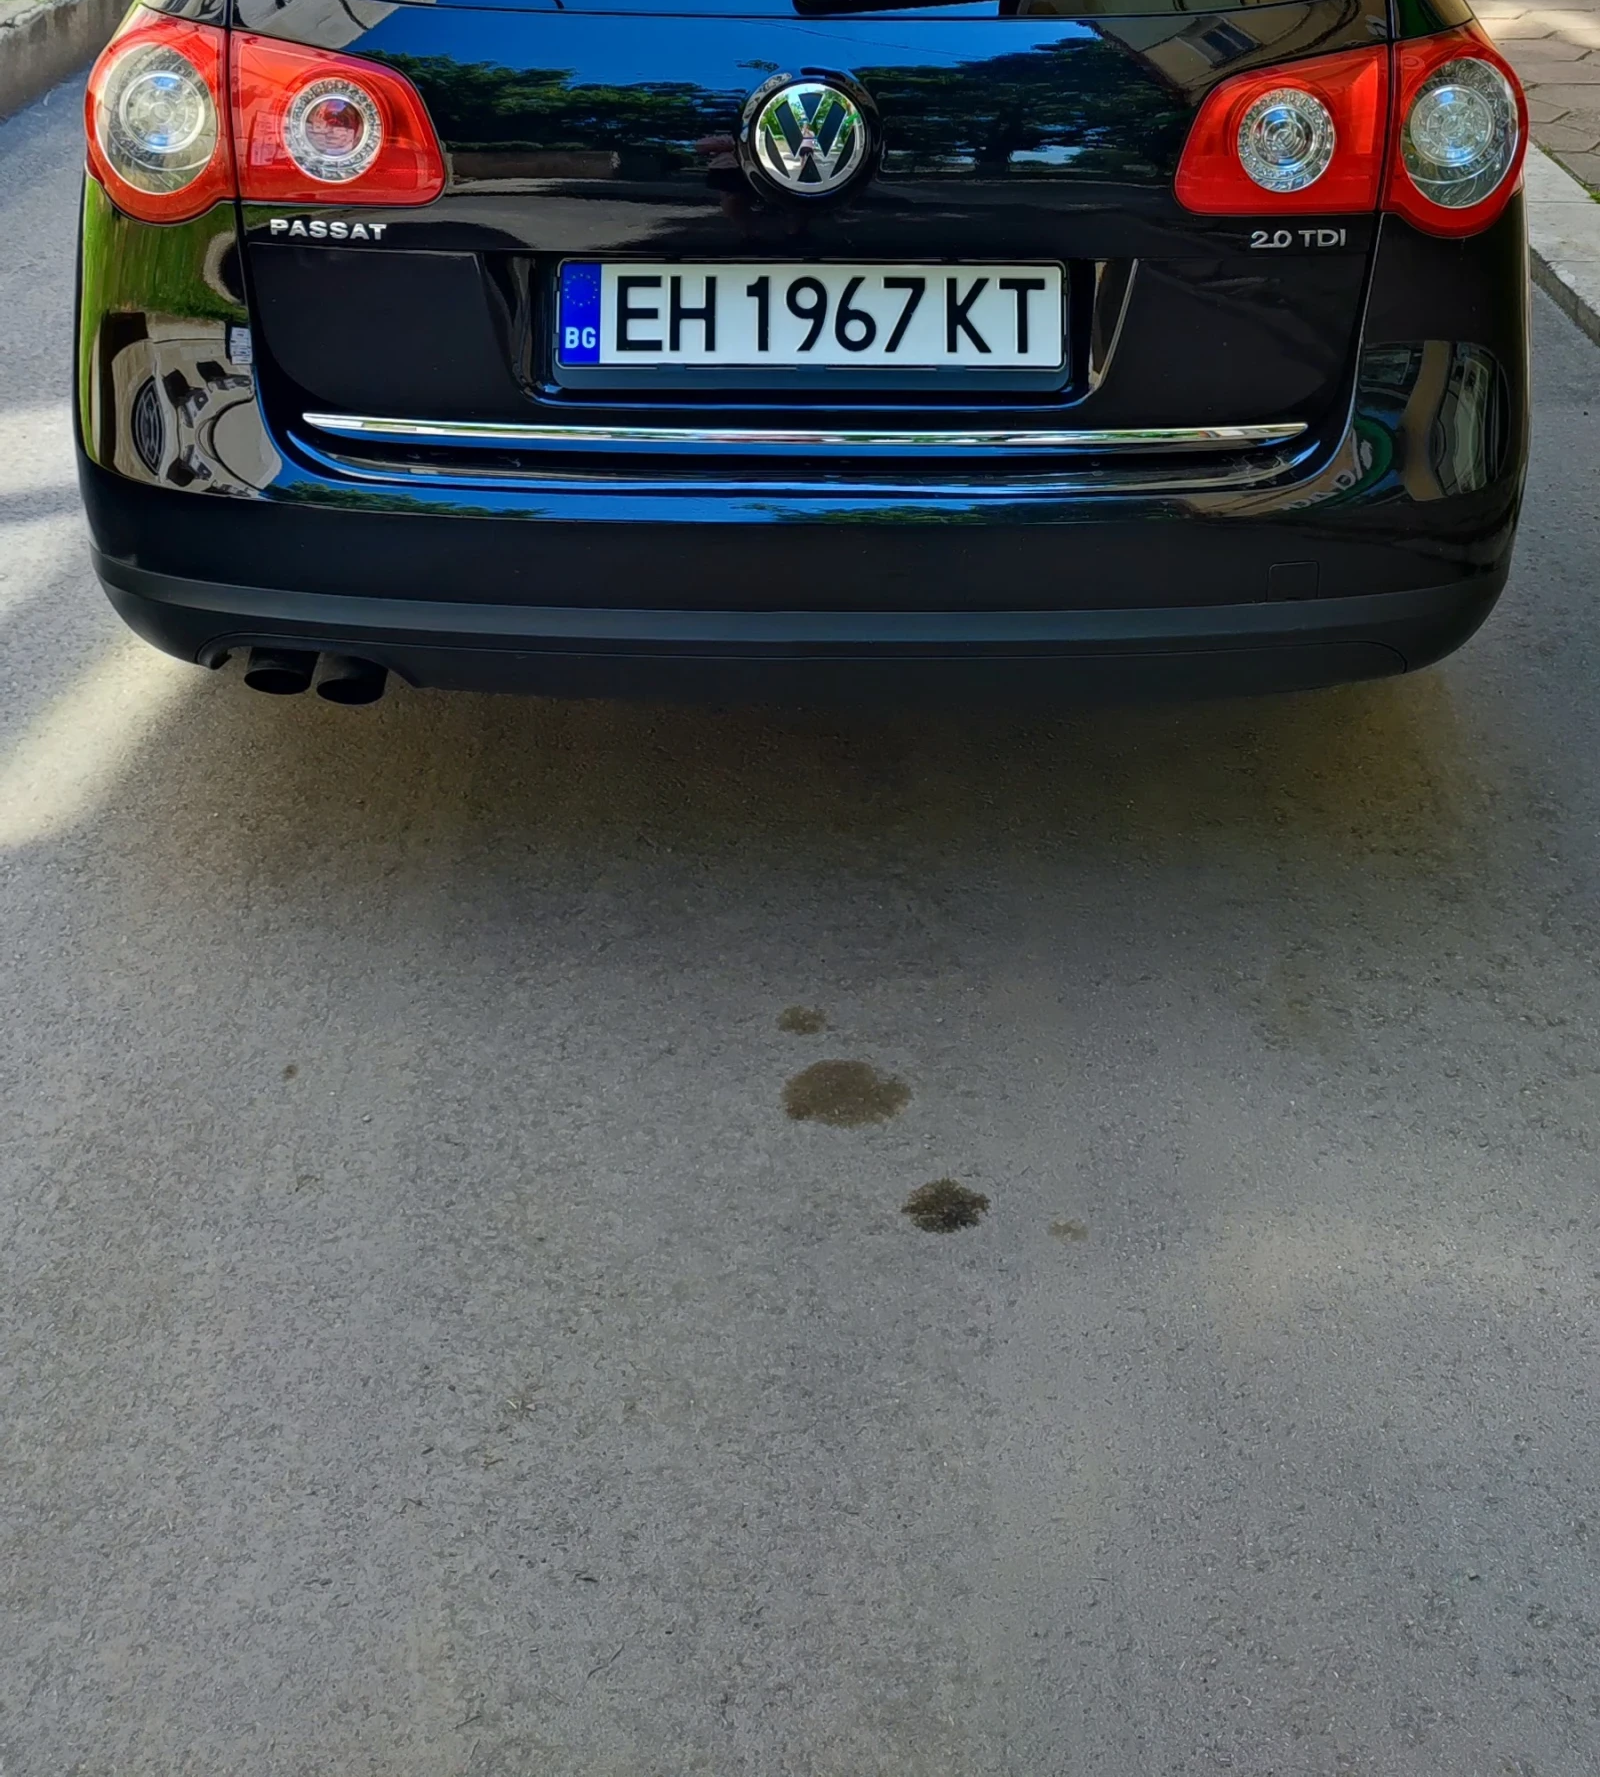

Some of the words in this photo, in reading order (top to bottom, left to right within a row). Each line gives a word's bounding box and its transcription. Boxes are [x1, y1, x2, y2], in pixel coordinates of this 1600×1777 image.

[269, 218, 387, 240] PASSAT
[1298, 228, 1347, 247] TDI
[615, 275, 717, 352] EH
[746, 275, 927, 353] 1967
[945, 277, 1046, 354] KT
[564, 326, 597, 349] BG
